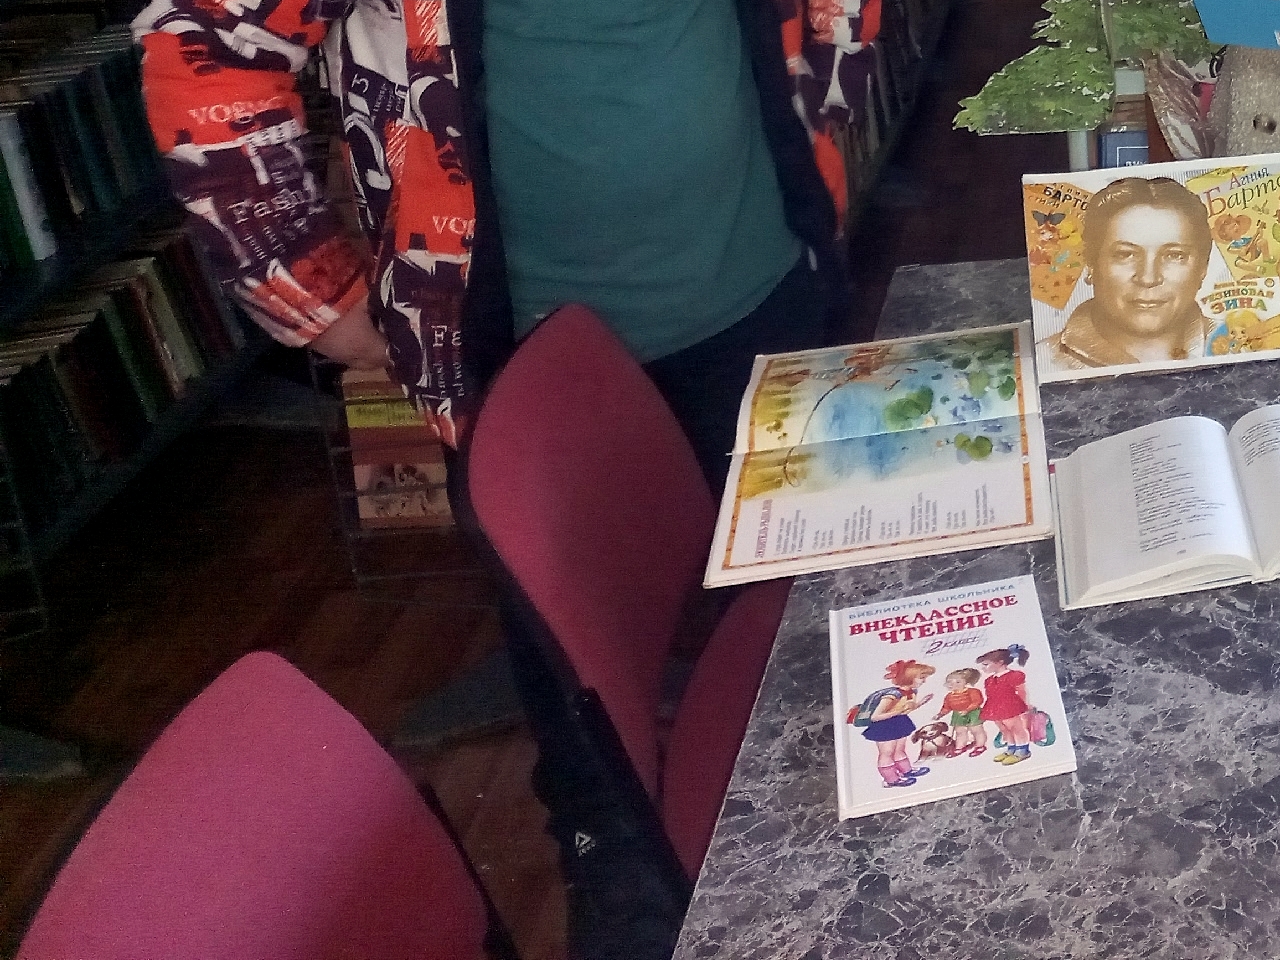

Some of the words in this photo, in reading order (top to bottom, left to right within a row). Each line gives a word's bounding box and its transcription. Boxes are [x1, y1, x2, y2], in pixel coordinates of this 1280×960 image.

[1229, 167, 1271, 191] Агния
[1043, 186, 1089, 211] БАРТО
[1200, 288, 1275, 305] РЕЗИНОВАЯ
[1210, 297, 1268, 315] ЗИНА
[849, 599, 931, 620] БИБЛИОТЕКА
[937, 584, 1016, 603] ШКОЛЬНИКА
[849, 594, 1018, 637] ВНЕКЛАССНОЕ
[878, 612, 994, 645] ЧТЕНИЕ
[925, 640, 943, 655] 2
